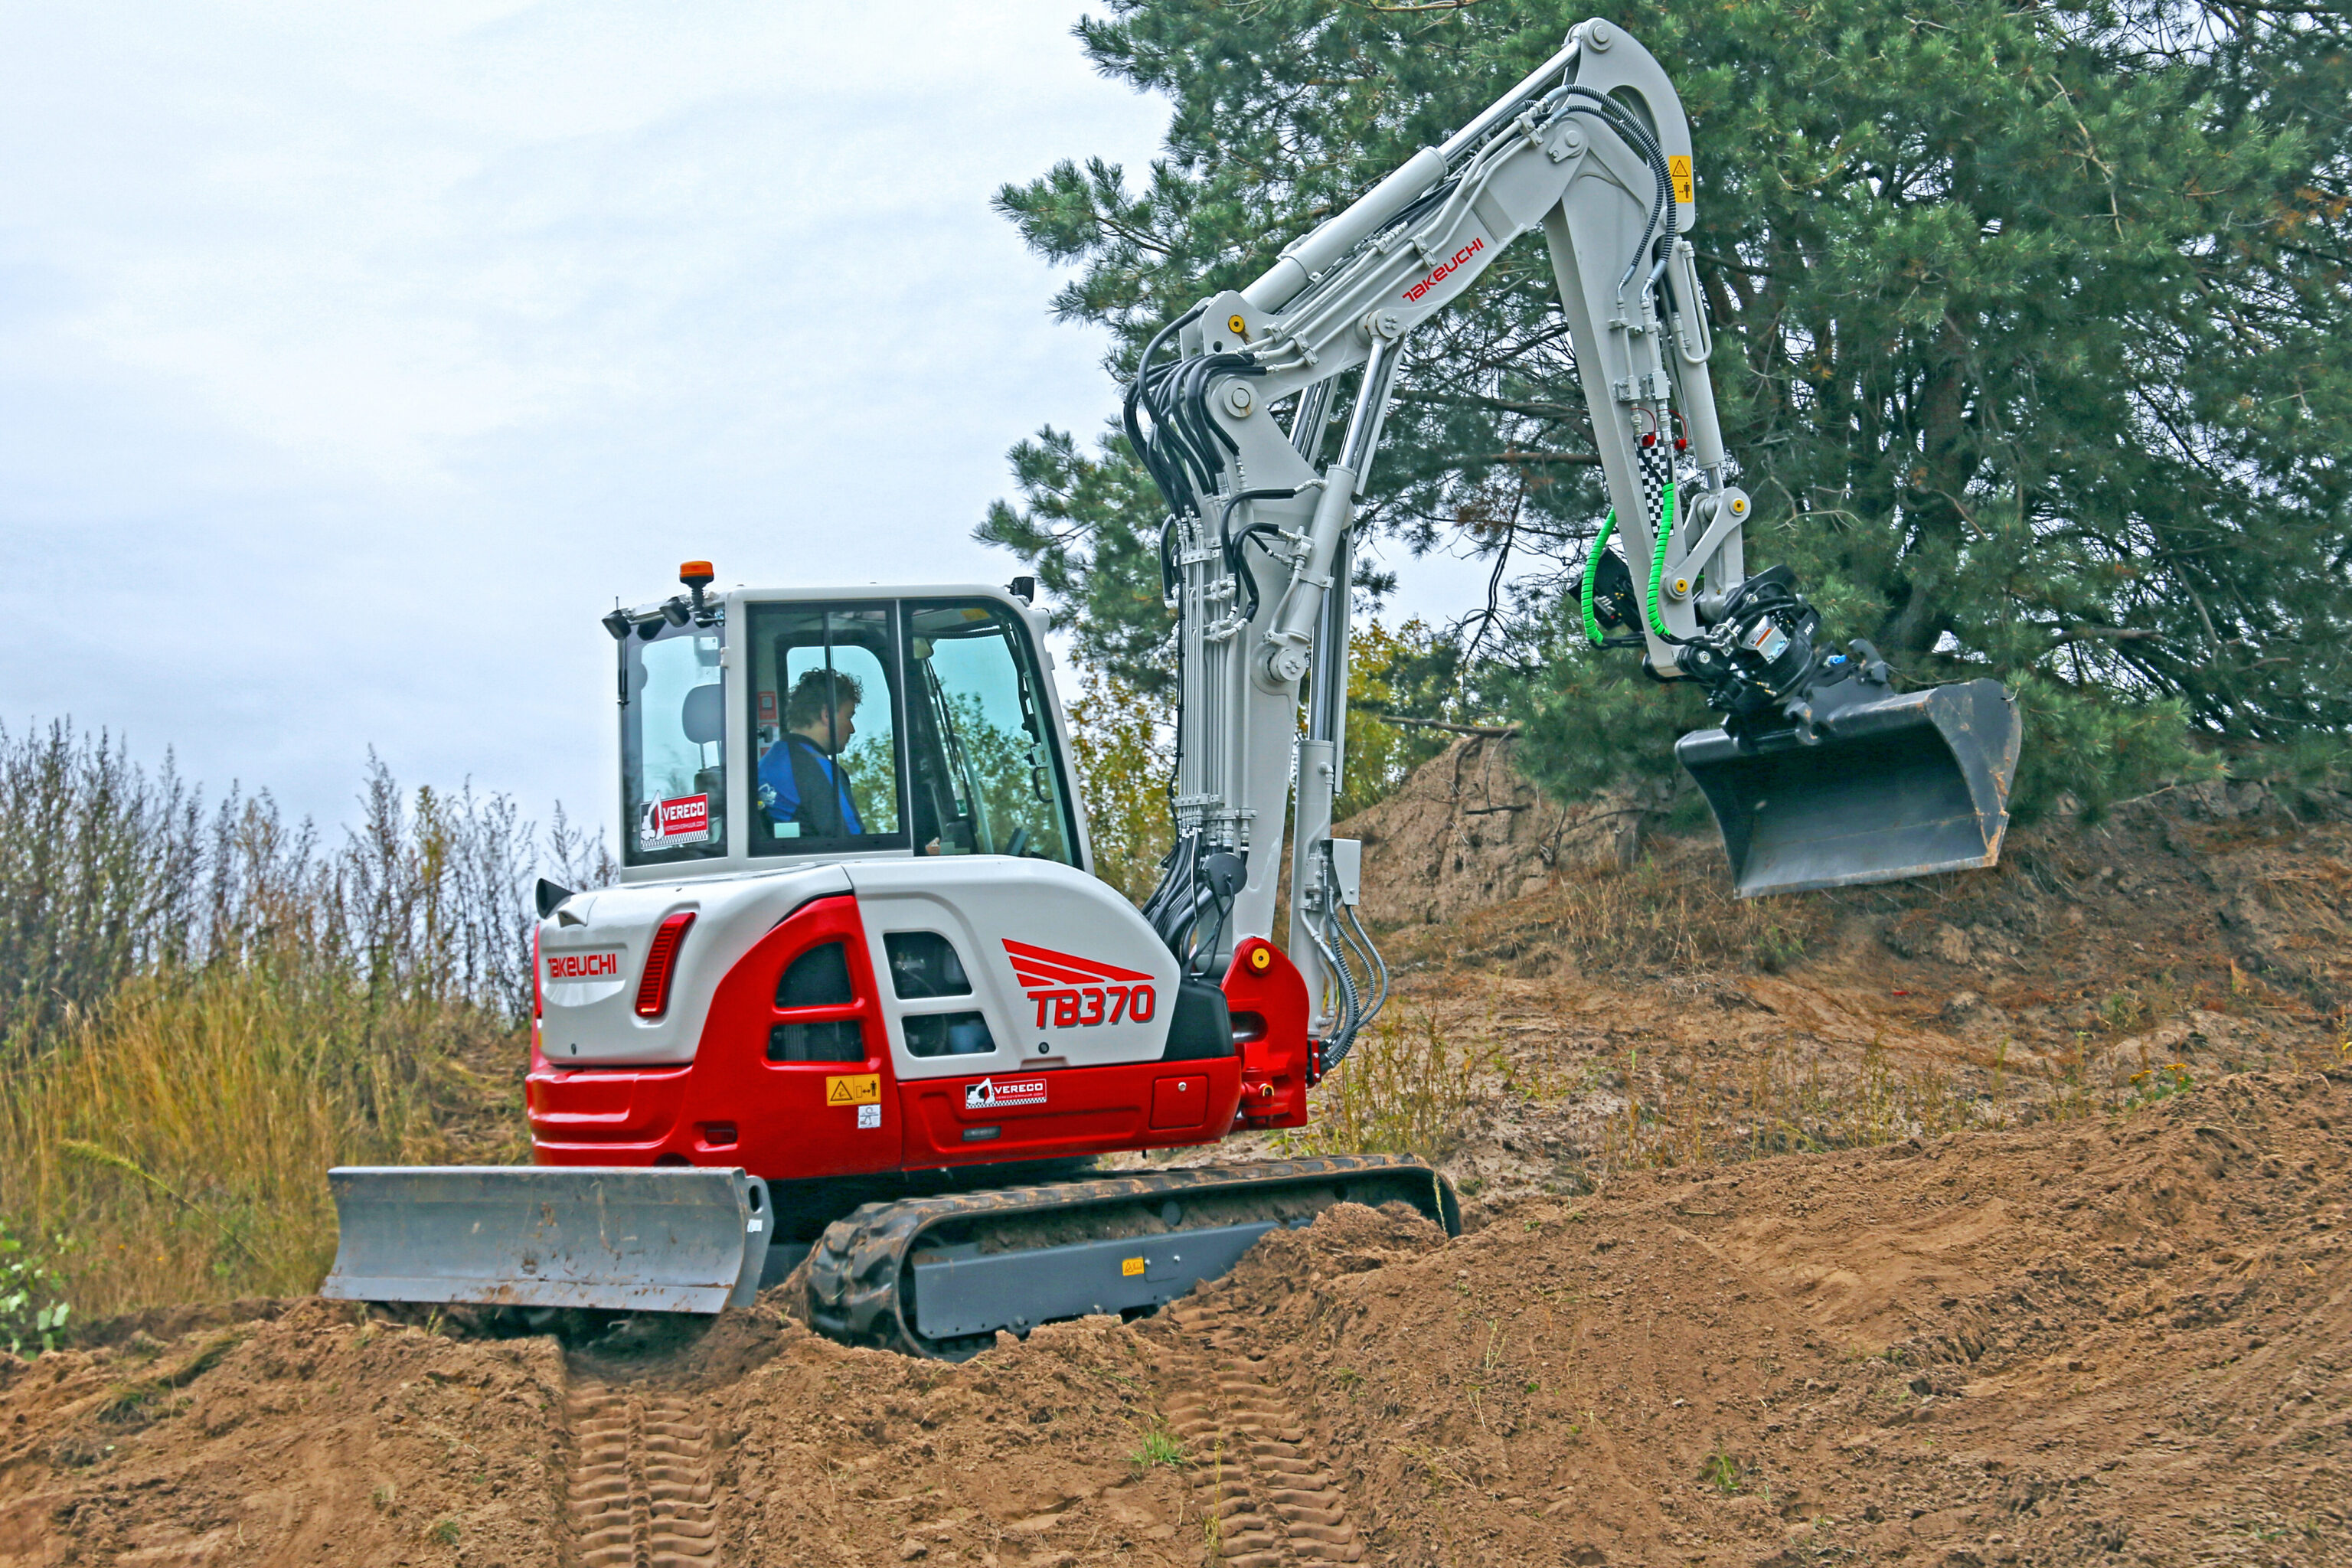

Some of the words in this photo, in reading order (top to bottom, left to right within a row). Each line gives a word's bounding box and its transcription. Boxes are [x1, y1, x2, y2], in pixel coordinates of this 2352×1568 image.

[663, 801, 705, 821] VERECO
[1027, 985, 1156, 1030] TB370
[994, 1083, 1043, 1094] VERECO
